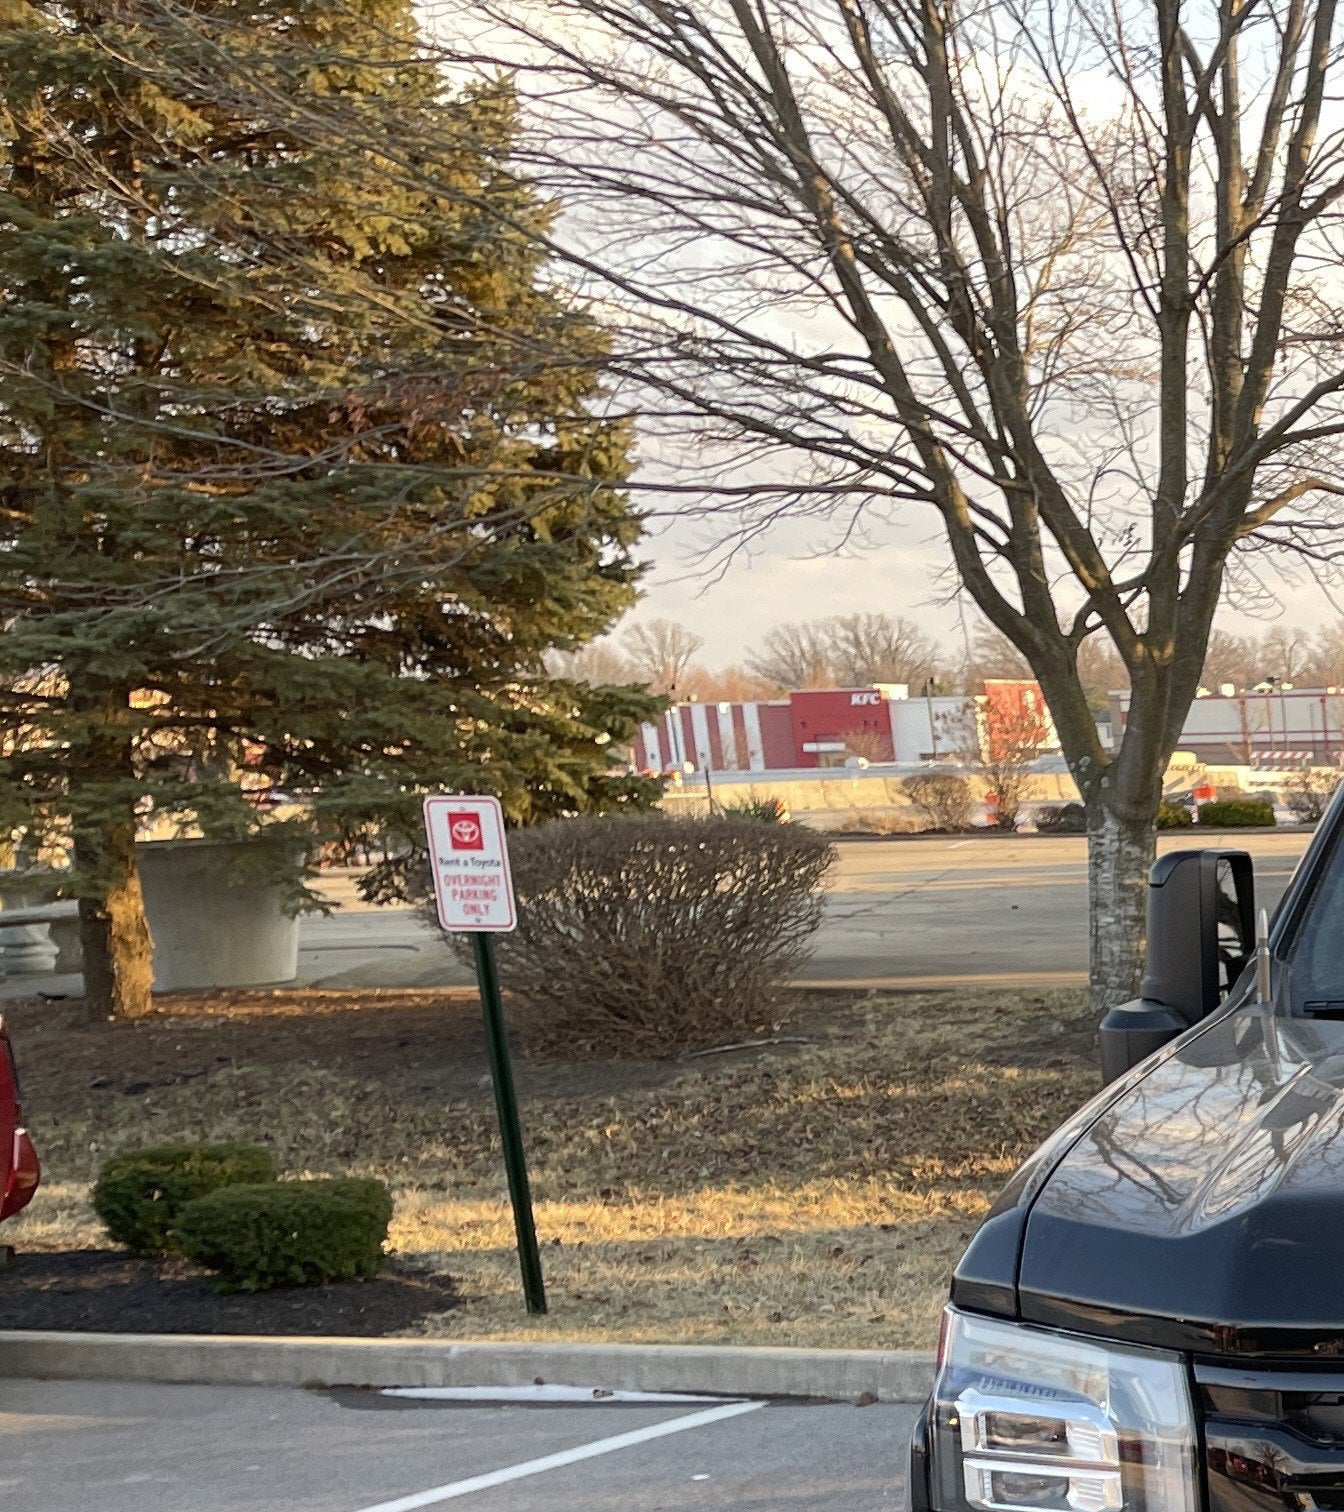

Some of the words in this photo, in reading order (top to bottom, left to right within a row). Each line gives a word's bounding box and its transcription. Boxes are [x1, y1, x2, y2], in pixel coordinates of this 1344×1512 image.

[850, 692, 880, 706] KFC
[444, 874, 500, 887] OVERNIGHT
[452, 889, 498, 901] PARKING
[463, 904, 490, 916] ONLY
